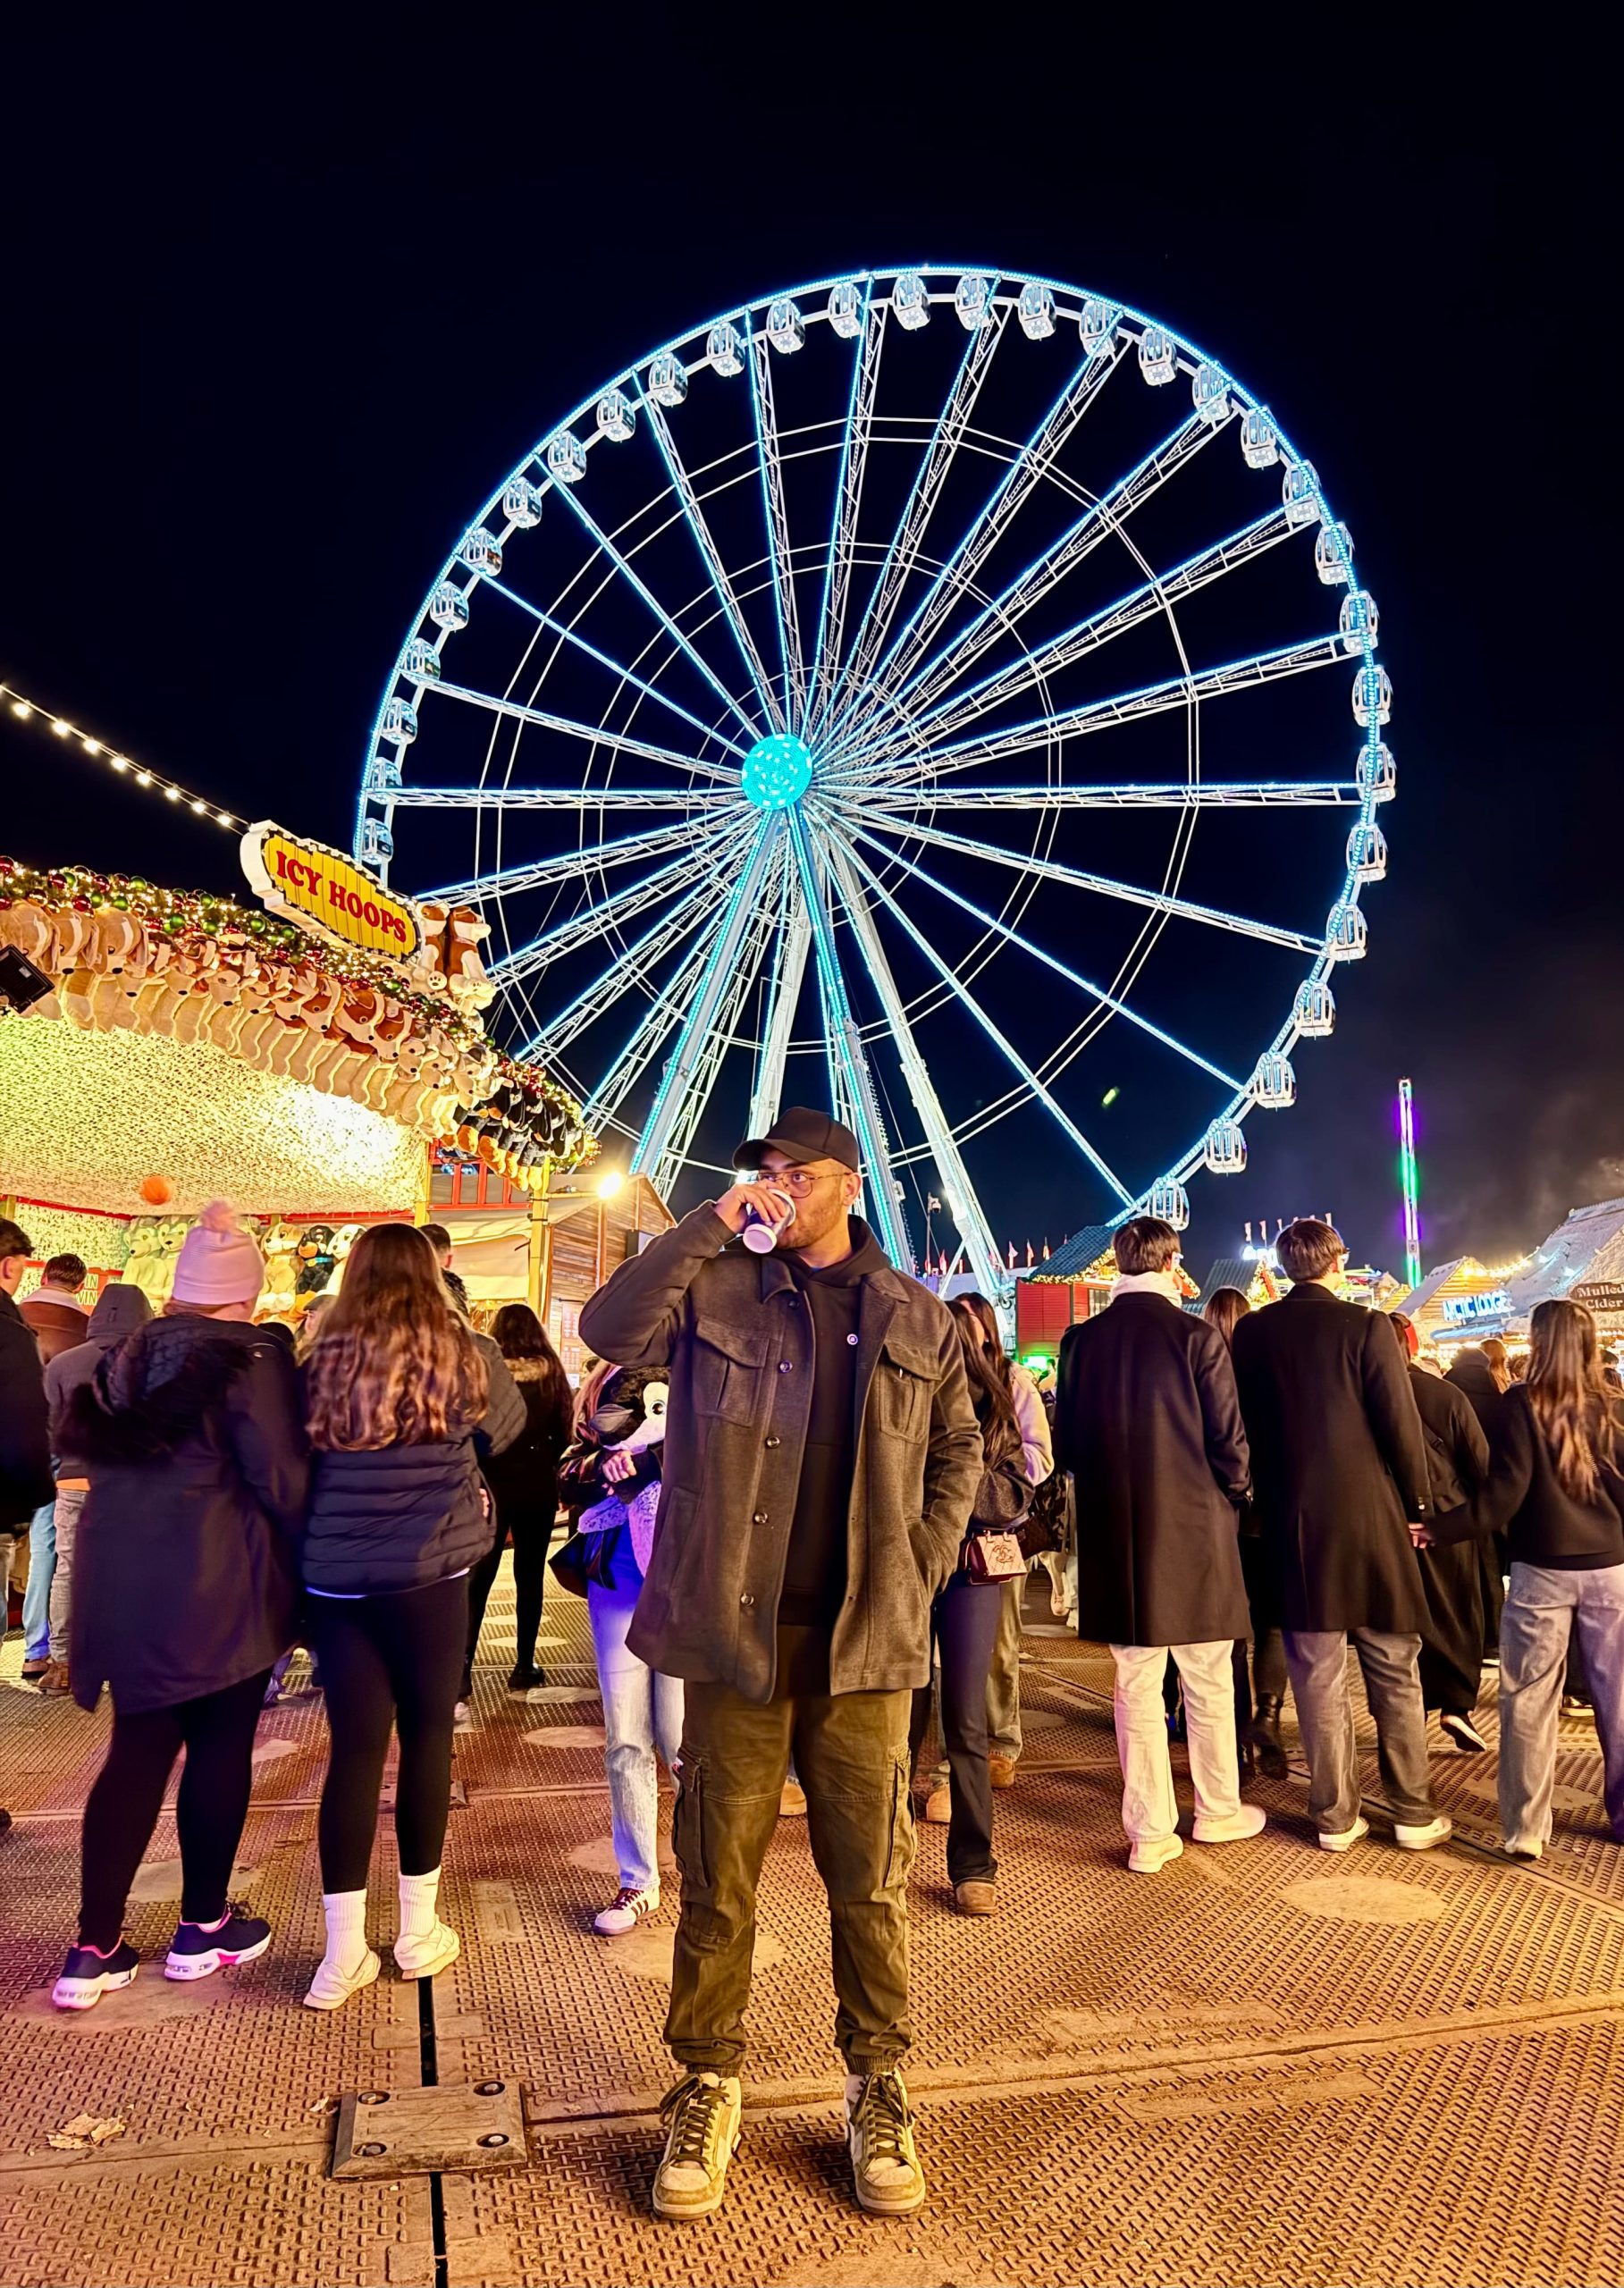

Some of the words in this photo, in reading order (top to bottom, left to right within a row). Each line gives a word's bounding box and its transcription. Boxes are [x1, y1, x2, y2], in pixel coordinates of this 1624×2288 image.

[276, 851, 322, 896] ICY
[329, 880, 407, 943] HOOPS
[1577, 1284, 1624, 1298] Mulled
[1586, 1299, 1623, 1309] Cider
